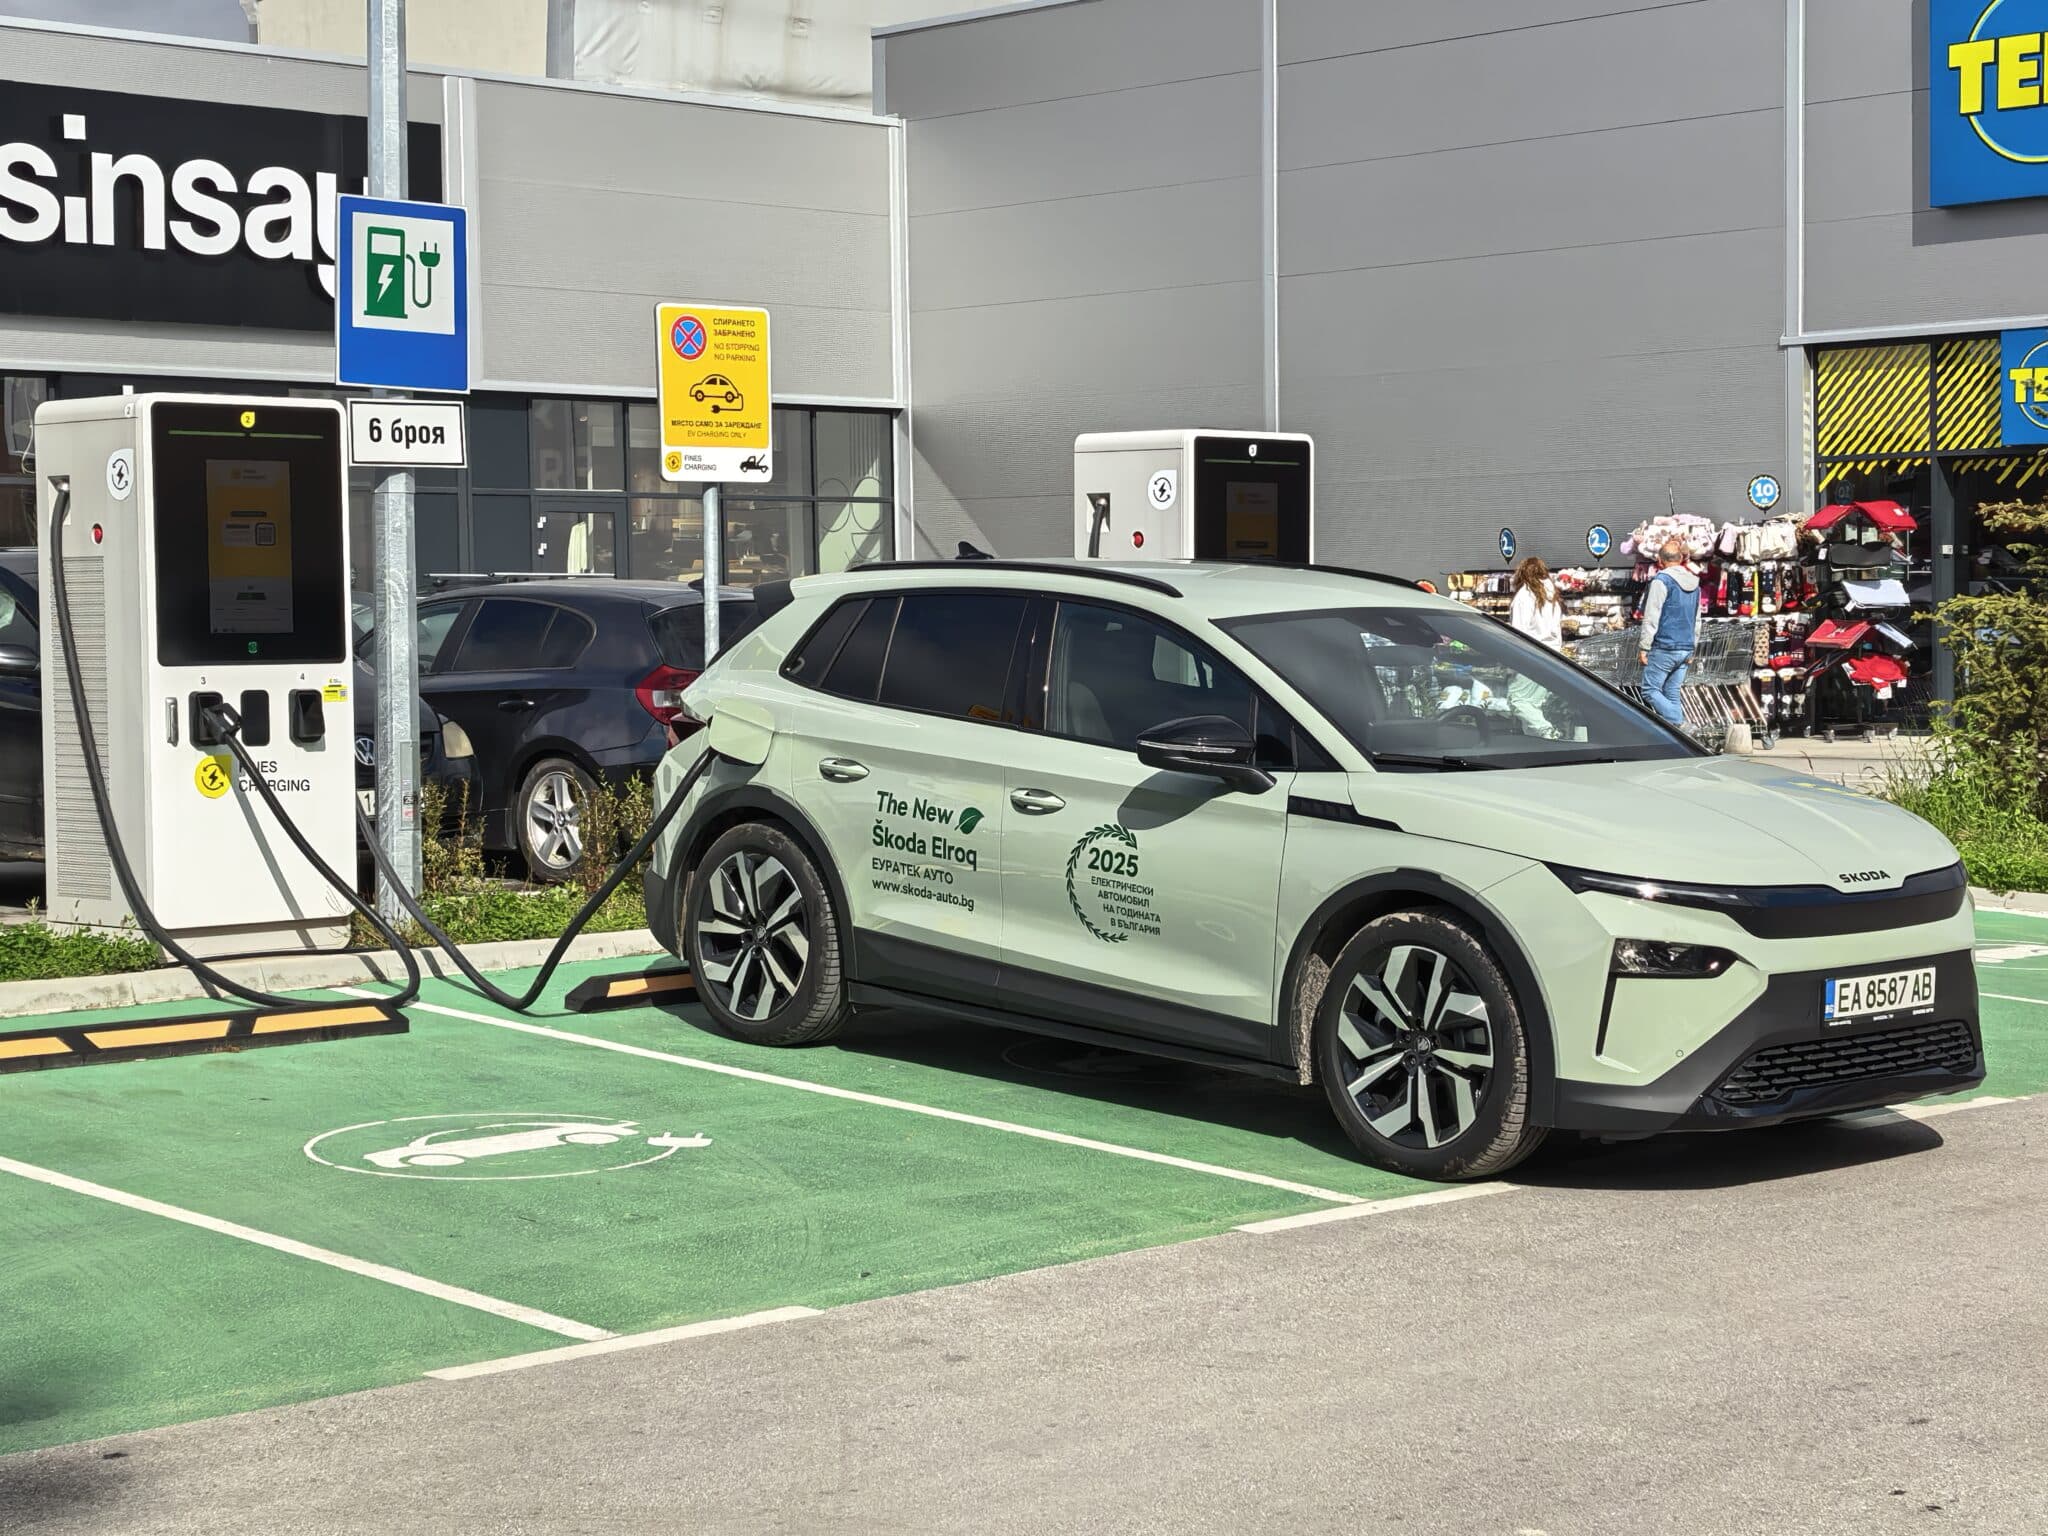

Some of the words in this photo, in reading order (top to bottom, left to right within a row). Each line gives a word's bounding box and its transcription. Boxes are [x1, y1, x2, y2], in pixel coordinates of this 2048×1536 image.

[1947, 31, 2048, 116] TE
[713, 318, 755, 327] СПИРАНЕТО
[714, 329, 756, 338] ЗАБРАНЕНО
[714, 343, 724, 351] NO
[726, 343, 760, 352] STOPPING
[714, 353, 724, 361] NO
[726, 354, 756, 362] PARKING
[245, 415, 251, 424] 2
[695, 420, 714, 428] САМО
[724, 421, 762, 429] ЗАРЕЖДАНЕ
[369, 417, 382, 443] 6
[391, 417, 445, 449] броя
[730, 431, 747, 439] ONLY
[1755, 482, 1774, 498] 10
[201, 677, 207, 685] 3
[300, 673, 305, 681] 4
[239, 779, 311, 792] CHRGING
[877, 790, 908, 817] The
[912, 797, 954, 825] New
[872, 818, 927, 855] Škoda
[931, 836, 978, 872] Elroq
[872, 857, 921, 879] ЕУРАТЕК
[923, 867, 954, 885] АУТО
[1087, 847, 1139, 878] 2025
[1839, 870, 1891, 884] SKODA
[1091, 876, 1154, 897] ЕЛЕКТРИЧЕСКИ
[872, 879, 975, 912] www.skoda-auto.bg
[1097, 889, 1150, 908] АВТОМОБИЛ
[1103, 903, 1115, 914] НА
[1116, 906, 1161, 924] ГОДИНАТА
[1110, 917, 1117, 927] В
[1118, 919, 1161, 936] БЪЛГАРИЯ
[1838, 981, 1862, 1013] EA
[1866, 975, 1909, 1009] 8587
[1911, 972, 1932, 1003] AB
